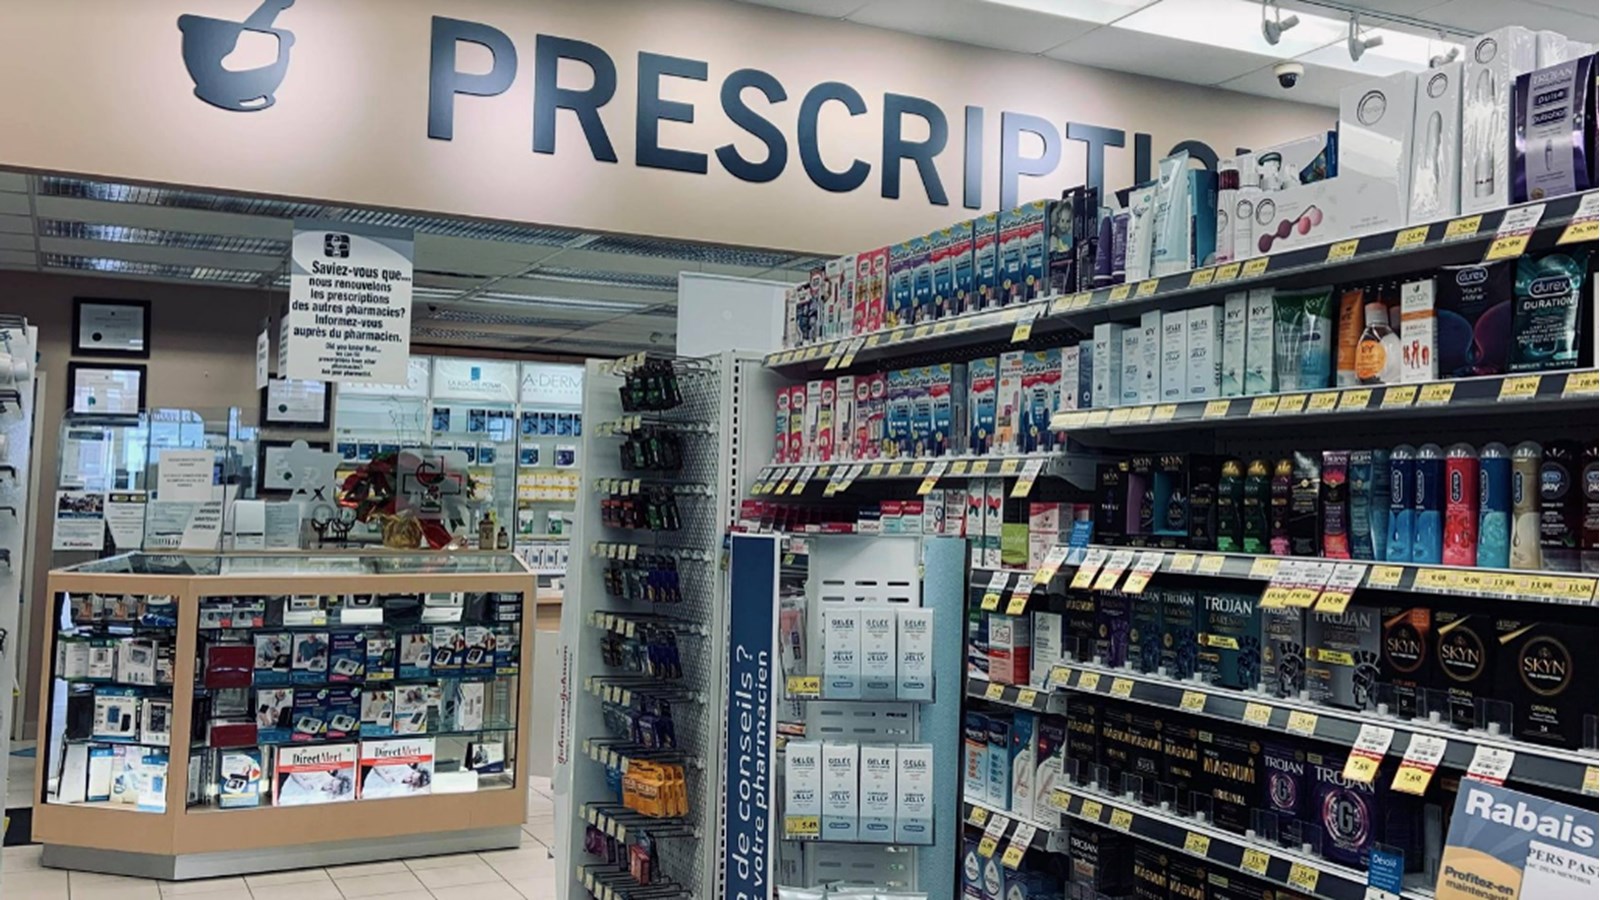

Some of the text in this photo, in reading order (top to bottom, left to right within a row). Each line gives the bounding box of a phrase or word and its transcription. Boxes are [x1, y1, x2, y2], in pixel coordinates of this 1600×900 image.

[427, 14, 1252, 212] PRESCRIPTI
[312, 260, 411, 283] Saviez-vous que...
[1459, 270, 1484, 281] durex
[309, 277, 392, 292] nous renouvelons
[1533, 280, 1568, 294] durex
[311, 288, 390, 305] les prescriptions
[1523, 297, 1575, 310] DURATION
[292, 300, 406, 318] des autres pharmacies?
[315, 314, 383, 329] Informez-vous
[293, 326, 402, 342] auprès du pharmacien.
[1162, 592, 1195, 606] TROJAN
[1203, 595, 1253, 615] TROJAN
[1314, 610, 1371, 629] TROJAN
[1387, 638, 1420, 654] SKYN
[1442, 644, 1479, 663] SKYN
[1524, 656, 1565, 675] SKYN
[736, 644, 754, 821] conseils ?
[752, 651, 768, 882] votre pharmacien
[1203, 756, 1256, 784] MAGNUM
[1264, 755, 1304, 776] TROJAN
[1314, 765, 1375, 794] TROJAN
[1465, 788, 1595, 848] Rabais
[1070, 836, 1100, 855] TROJAN
[732, 835, 752, 880] de
[1444, 865, 1515, 897] Profitez-en
